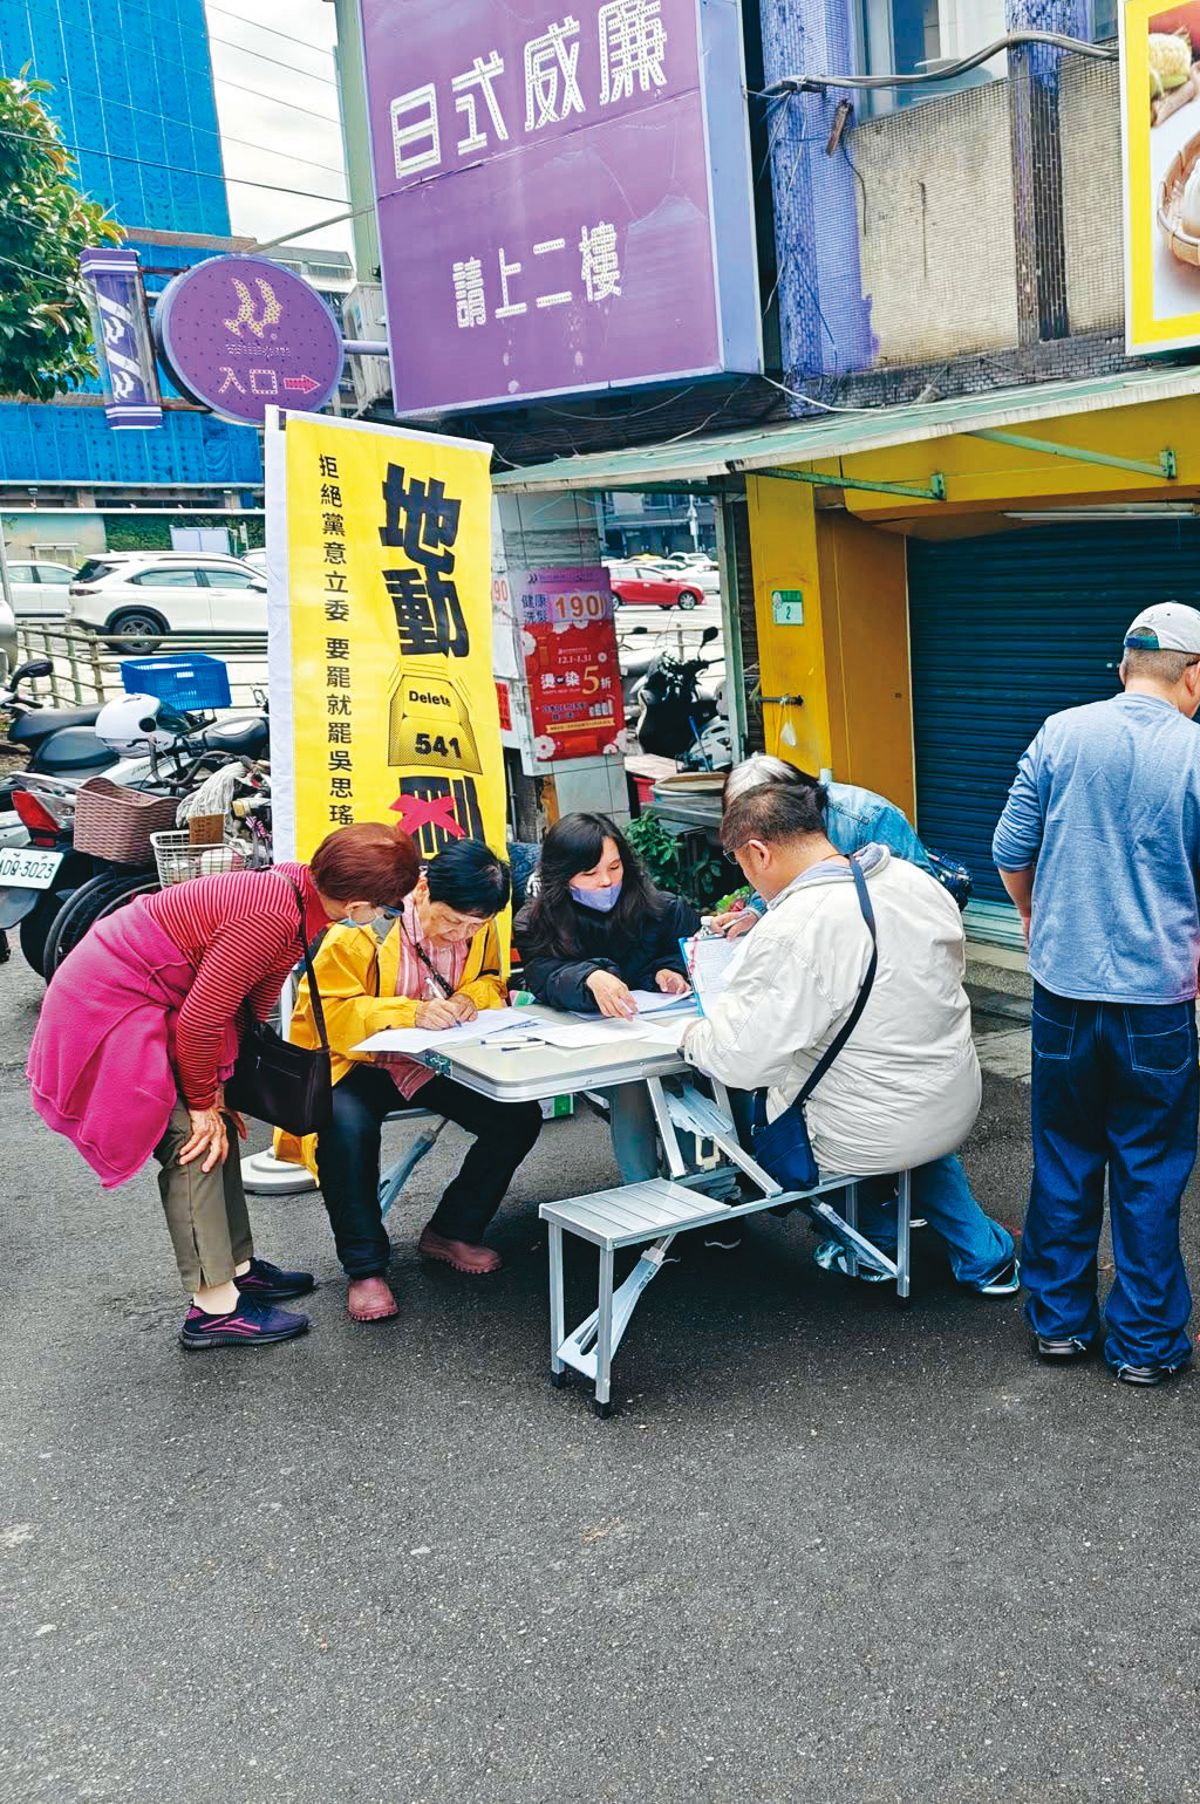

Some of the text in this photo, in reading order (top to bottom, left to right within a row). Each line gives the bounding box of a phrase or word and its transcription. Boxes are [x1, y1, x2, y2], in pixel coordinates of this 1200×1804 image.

[390, 0, 668, 179] 日式威廉
[452, 220, 622, 329] 請上二樓
[218, 366, 279, 395] 入口
[377, 461, 470, 659] 地動
[555, 594, 600, 618] 190
[318, 453, 355, 826] 拒絕黨意立委 要罷就罷吳思瑤
[414, 732, 463, 760] 541
